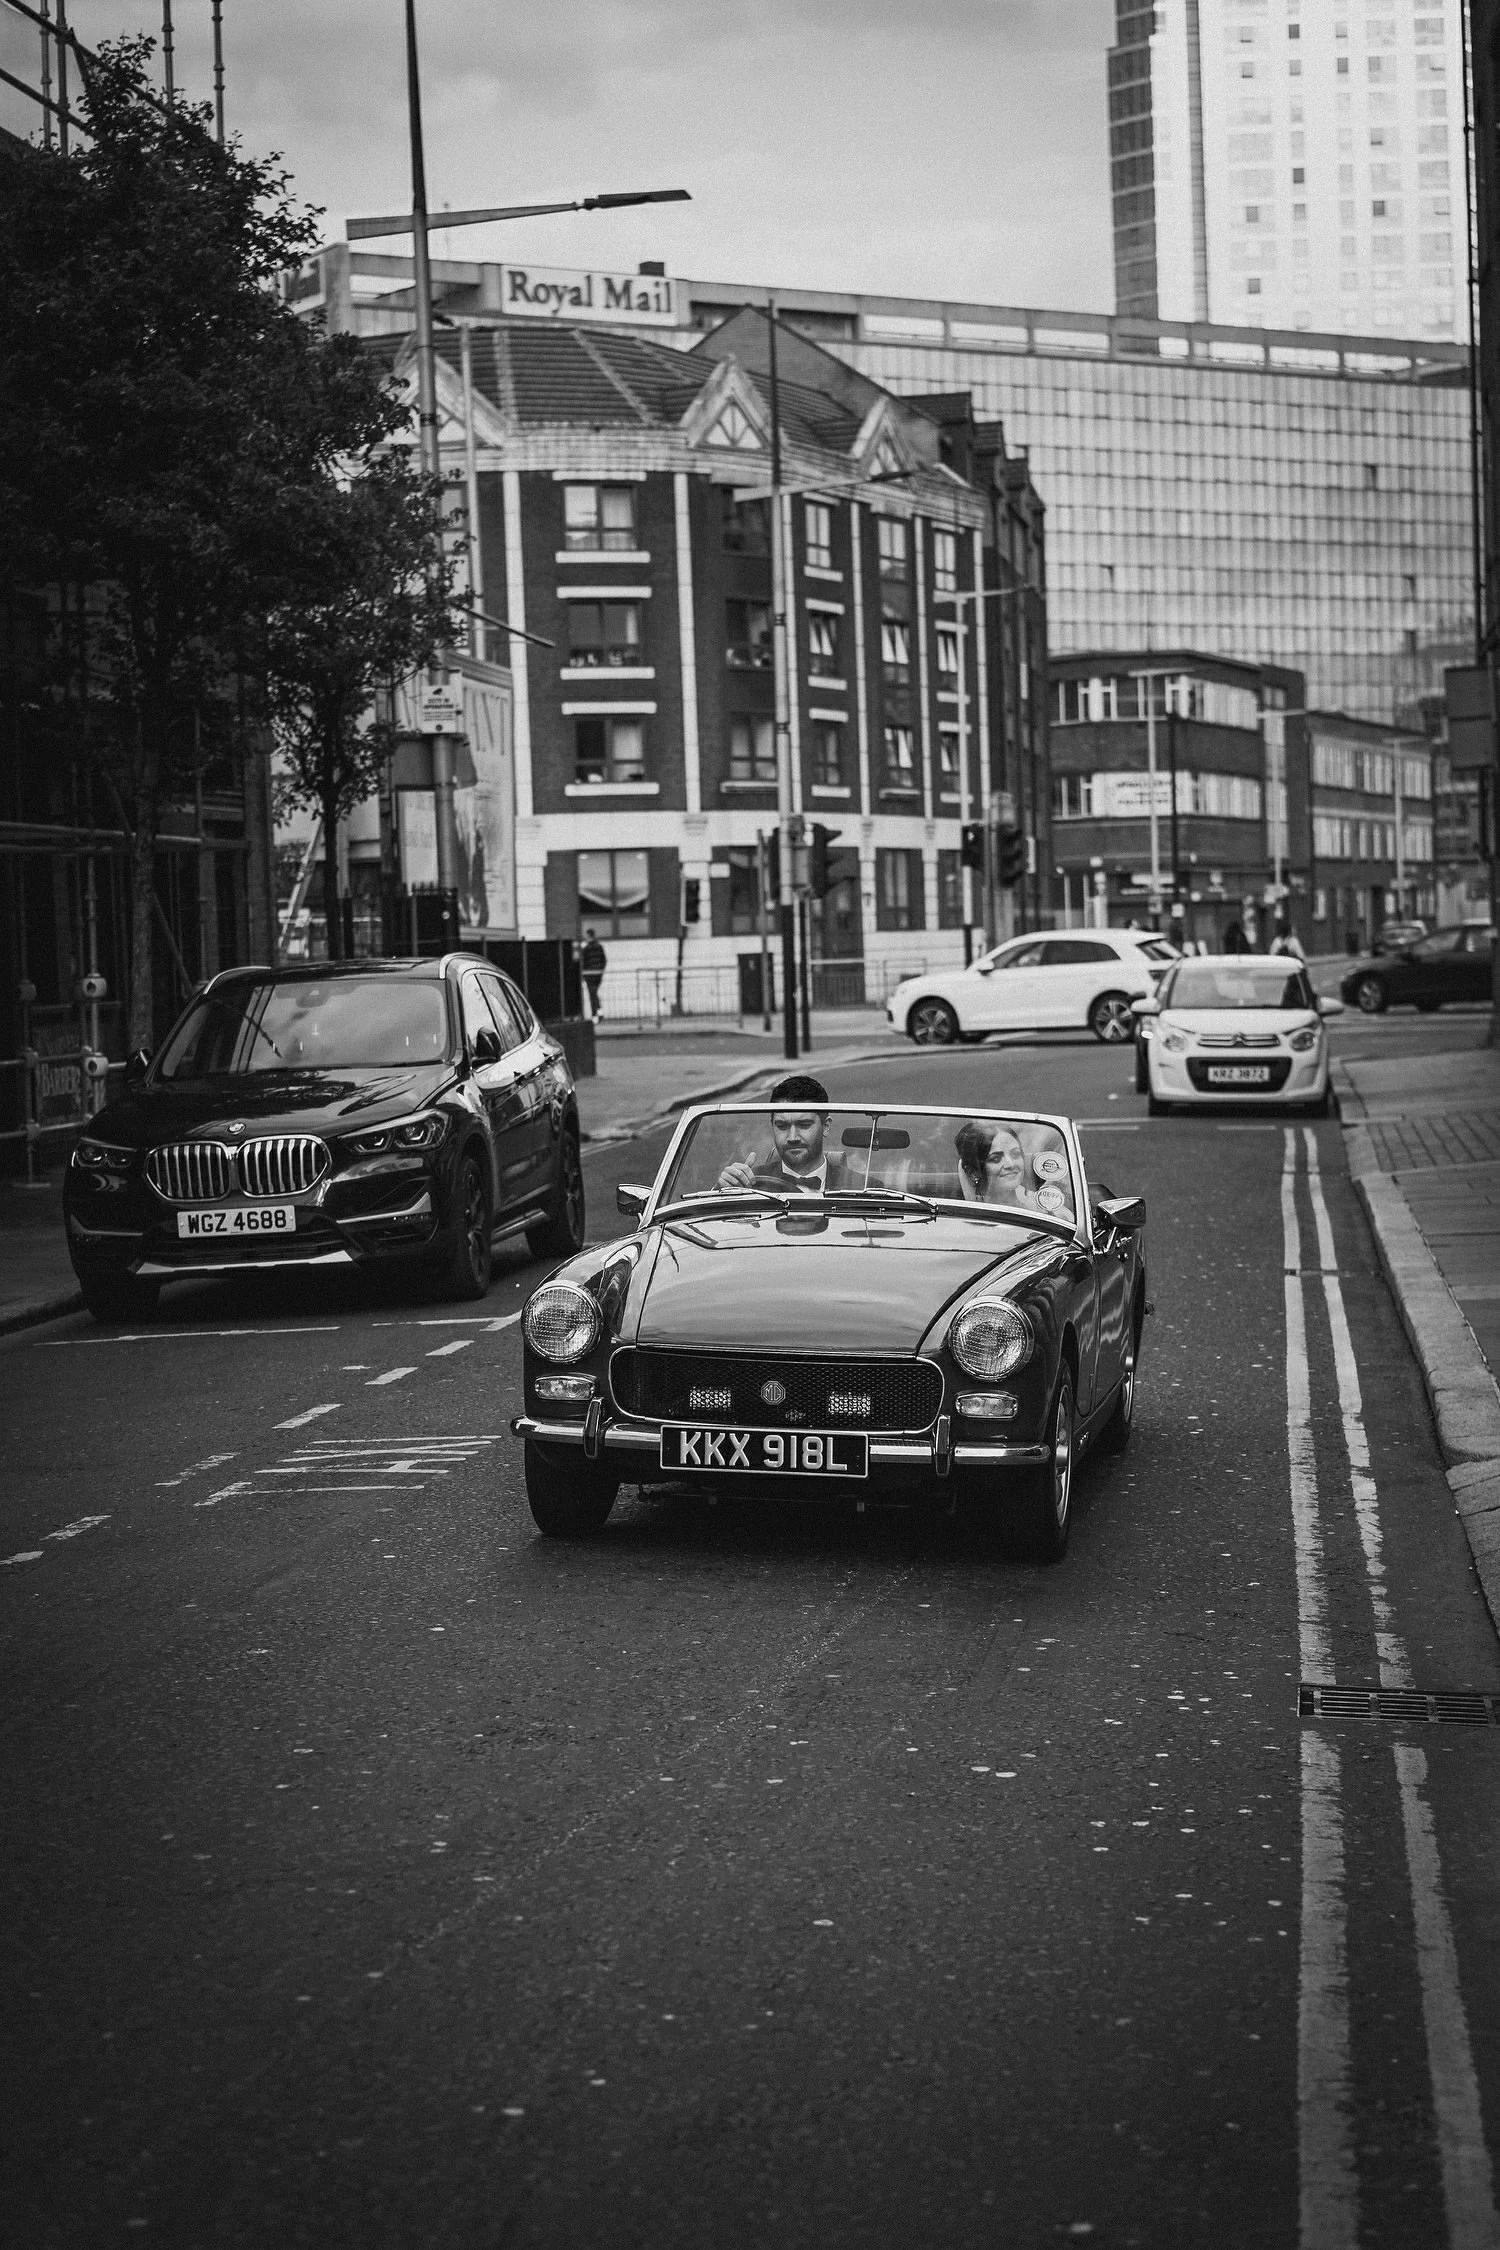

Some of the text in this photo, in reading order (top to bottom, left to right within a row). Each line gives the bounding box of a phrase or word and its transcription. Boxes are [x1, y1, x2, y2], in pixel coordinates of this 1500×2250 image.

[507, 270, 671, 316] Royal Mail
[188, 1209, 287, 1234] WGZ 4688
[765, 1385, 781, 1401] MG
[680, 1431, 848, 1471] KKX 918L
